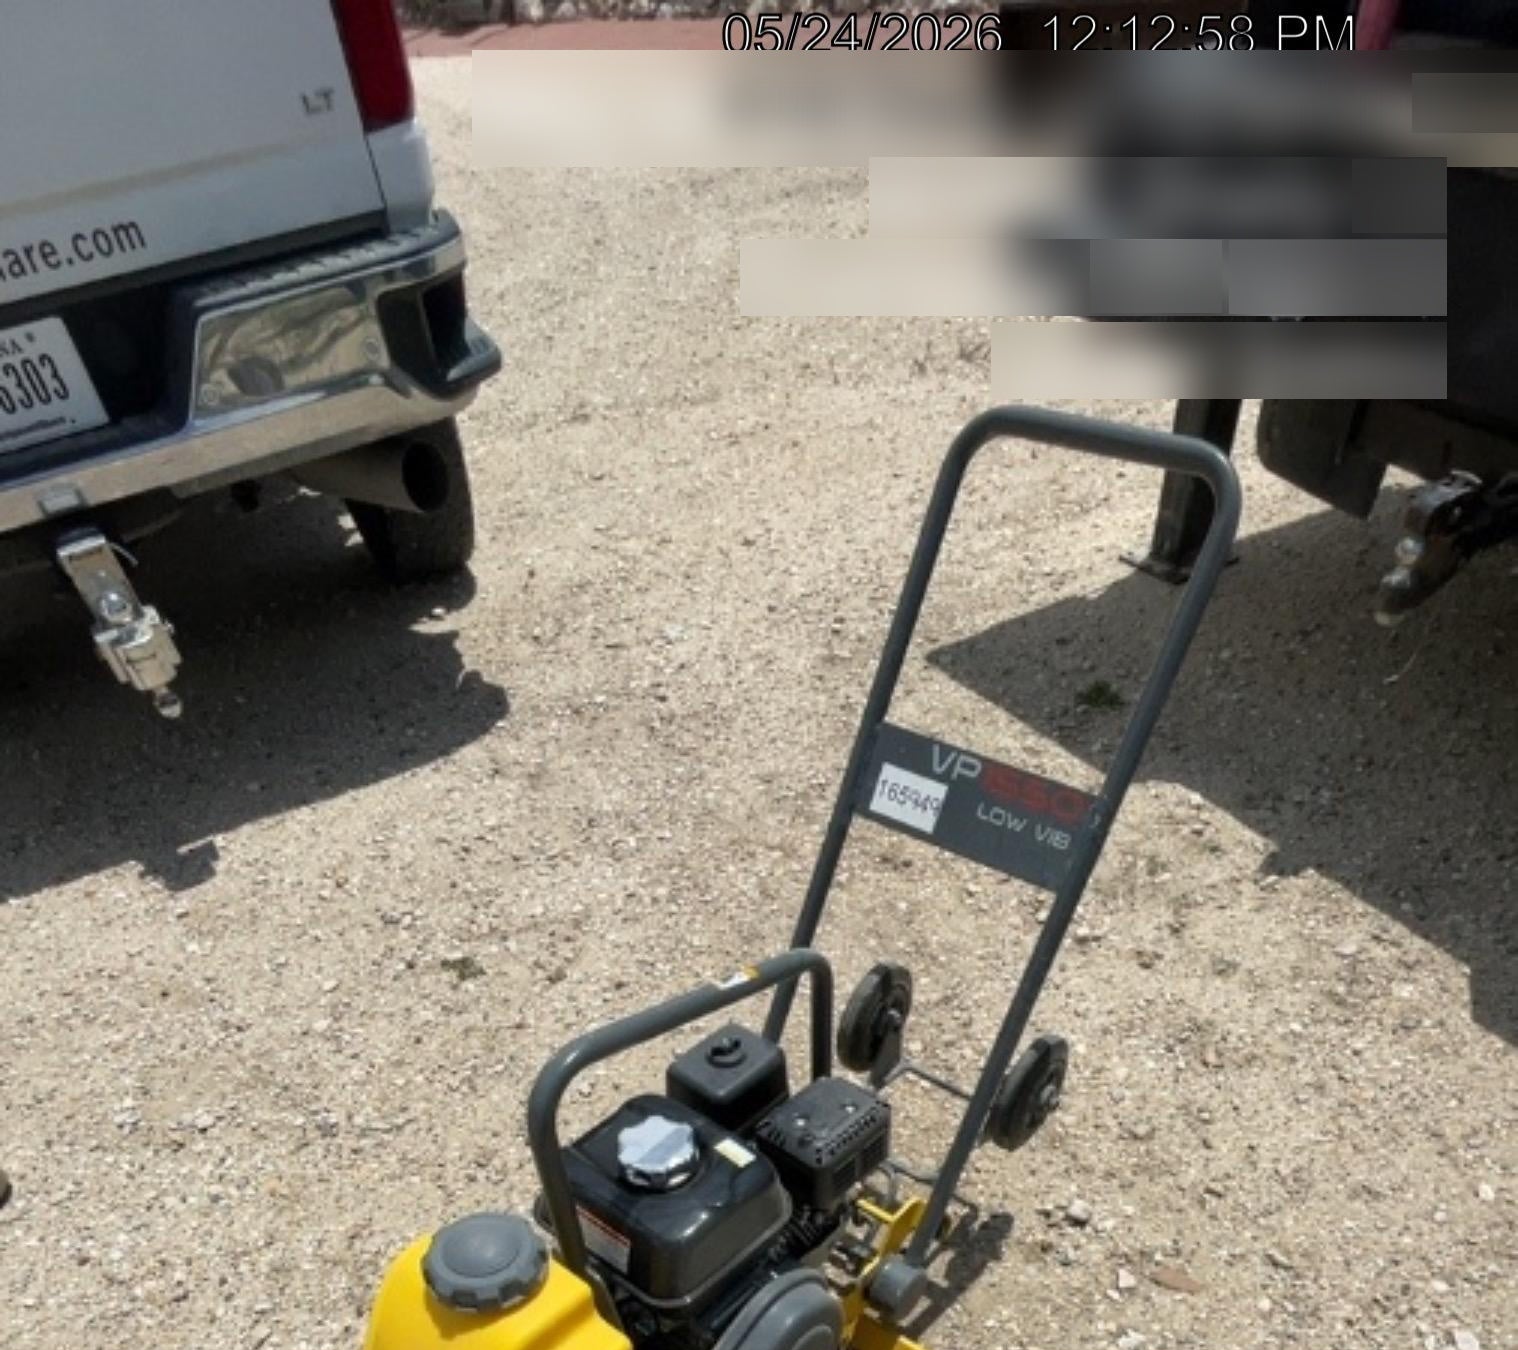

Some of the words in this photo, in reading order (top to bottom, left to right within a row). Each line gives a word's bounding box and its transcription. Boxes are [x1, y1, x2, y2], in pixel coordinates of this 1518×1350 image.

[301, 87, 335, 115] LT
[0, 221, 147, 282] are.com
[977, 802, 1028, 833] LOW
[1034, 823, 1072, 850] VIB
